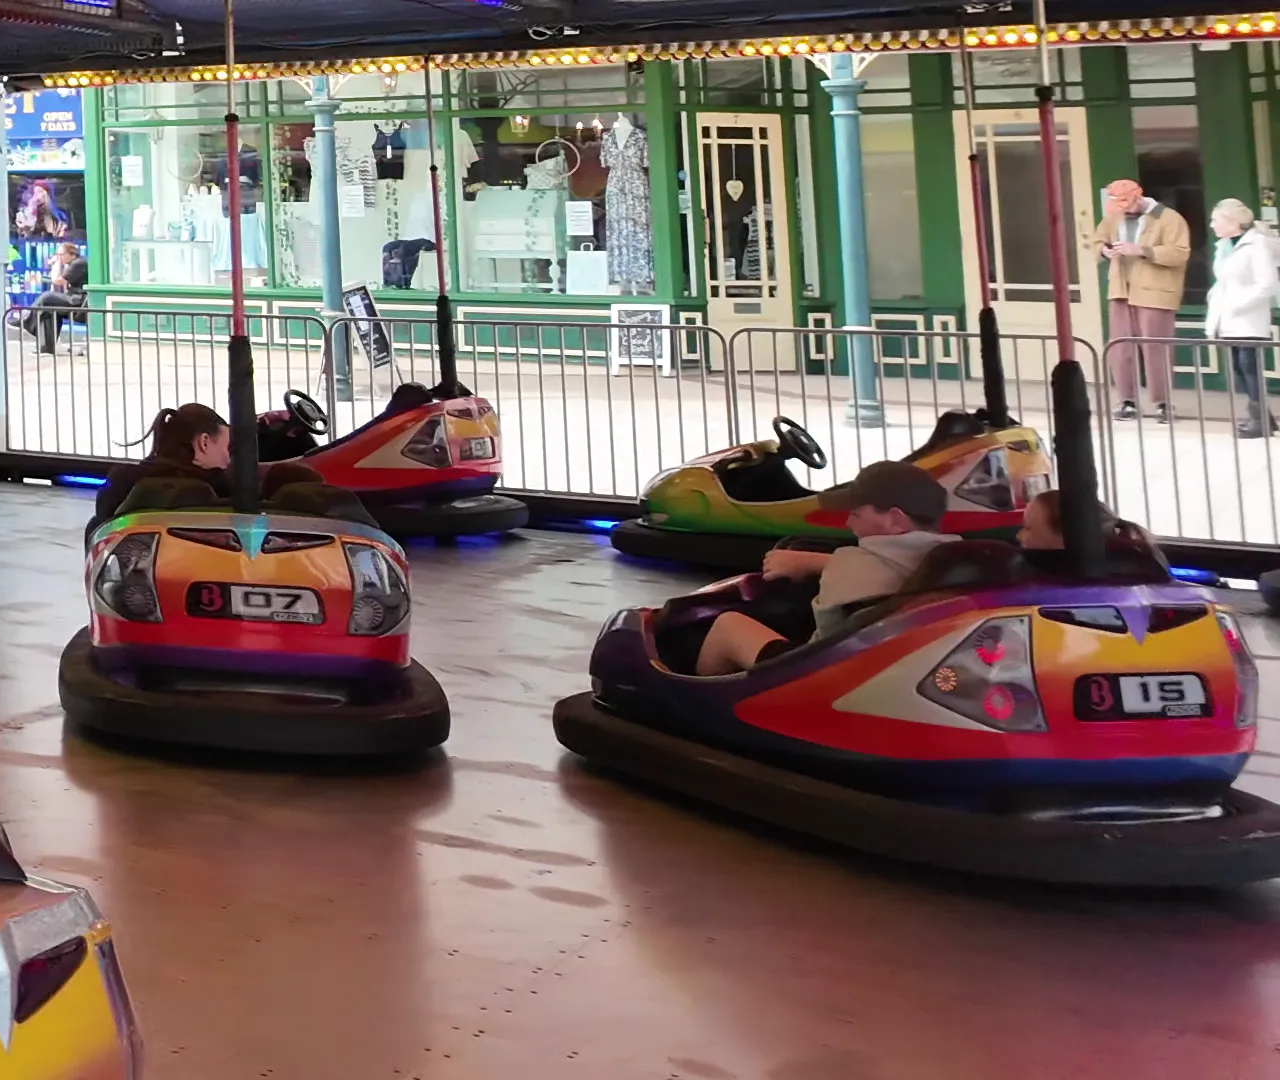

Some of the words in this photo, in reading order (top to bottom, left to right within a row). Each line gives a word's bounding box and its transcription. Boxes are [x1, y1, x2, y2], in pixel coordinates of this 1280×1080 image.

[42, 111, 73, 121] OPEN
[48, 121, 76, 131] DAYS
[243, 591, 302, 610] 07
[1139, 681, 1185, 703] 15
